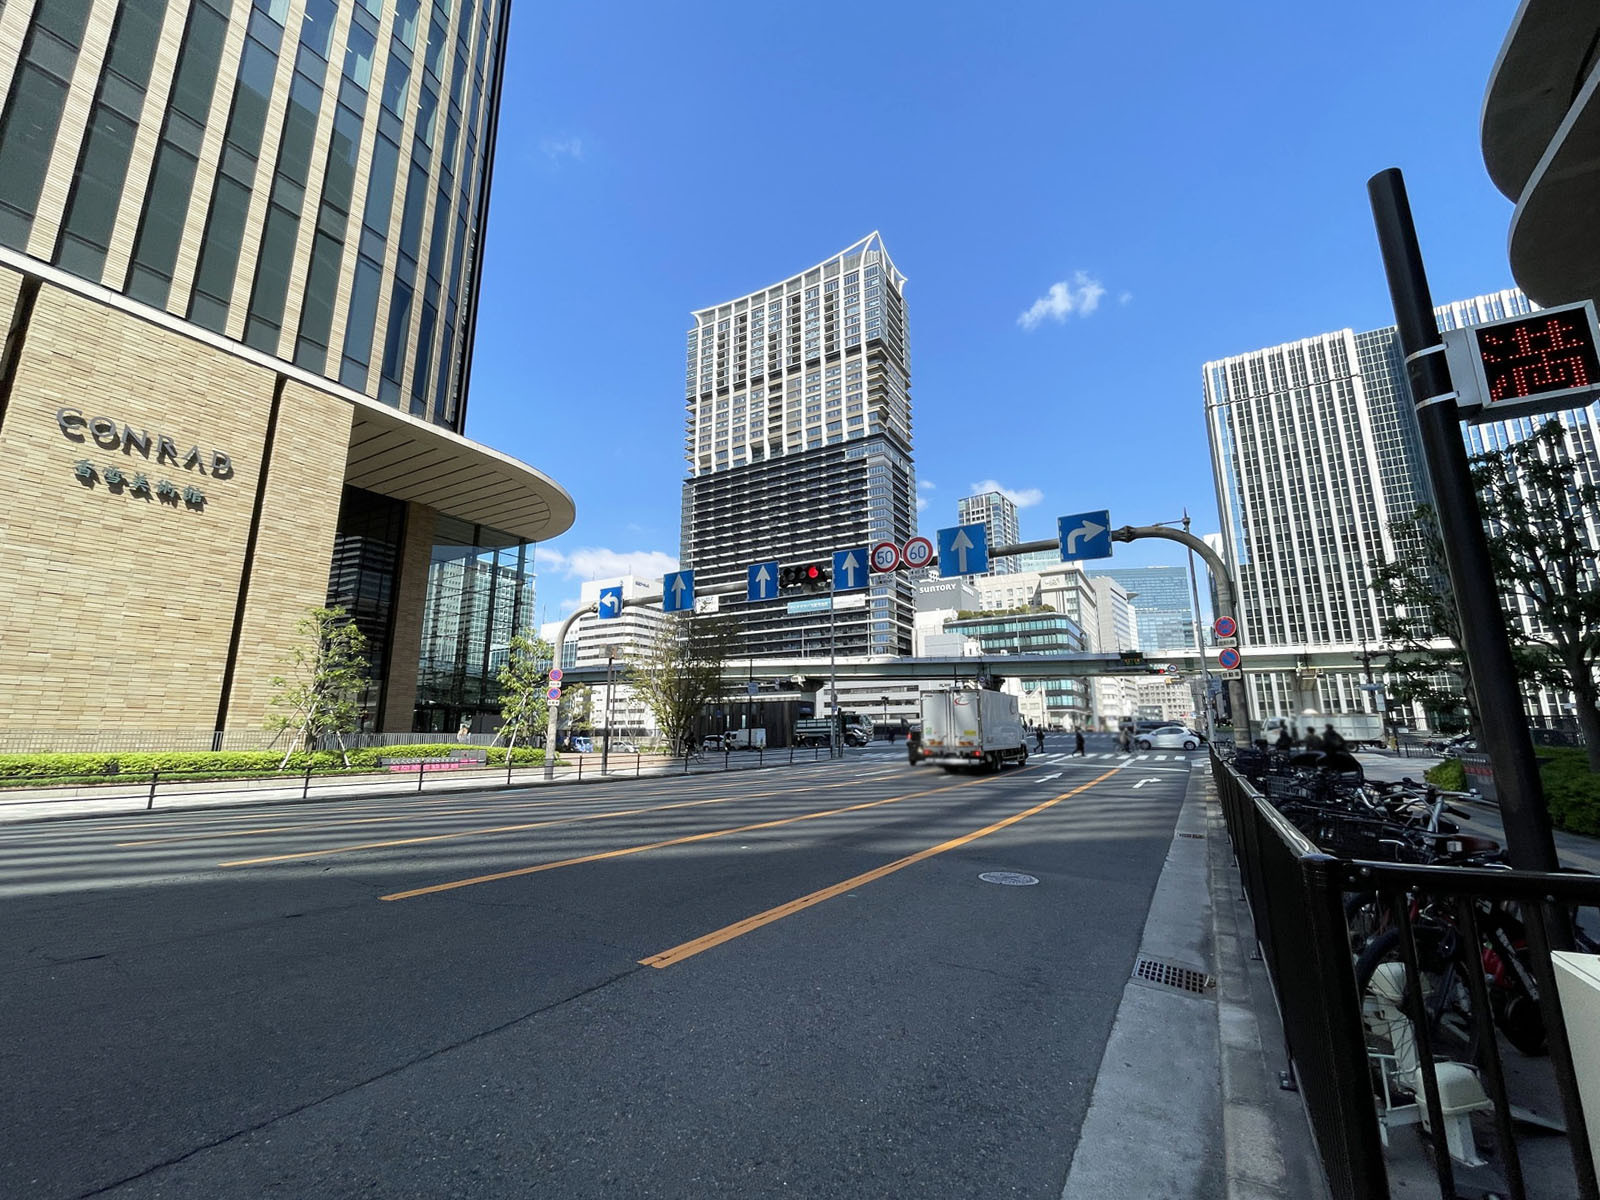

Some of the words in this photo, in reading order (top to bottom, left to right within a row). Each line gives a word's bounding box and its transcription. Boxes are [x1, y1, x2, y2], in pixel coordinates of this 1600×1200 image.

[1482, 320, 1588, 401] 満
[56, 407, 233, 471] CONRAD
[73, 459, 205, 504] 香雪美術館
[876, 550, 894, 565] 50
[909, 545, 927, 560] 60
[919, 583, 957, 594] SUNTORY
